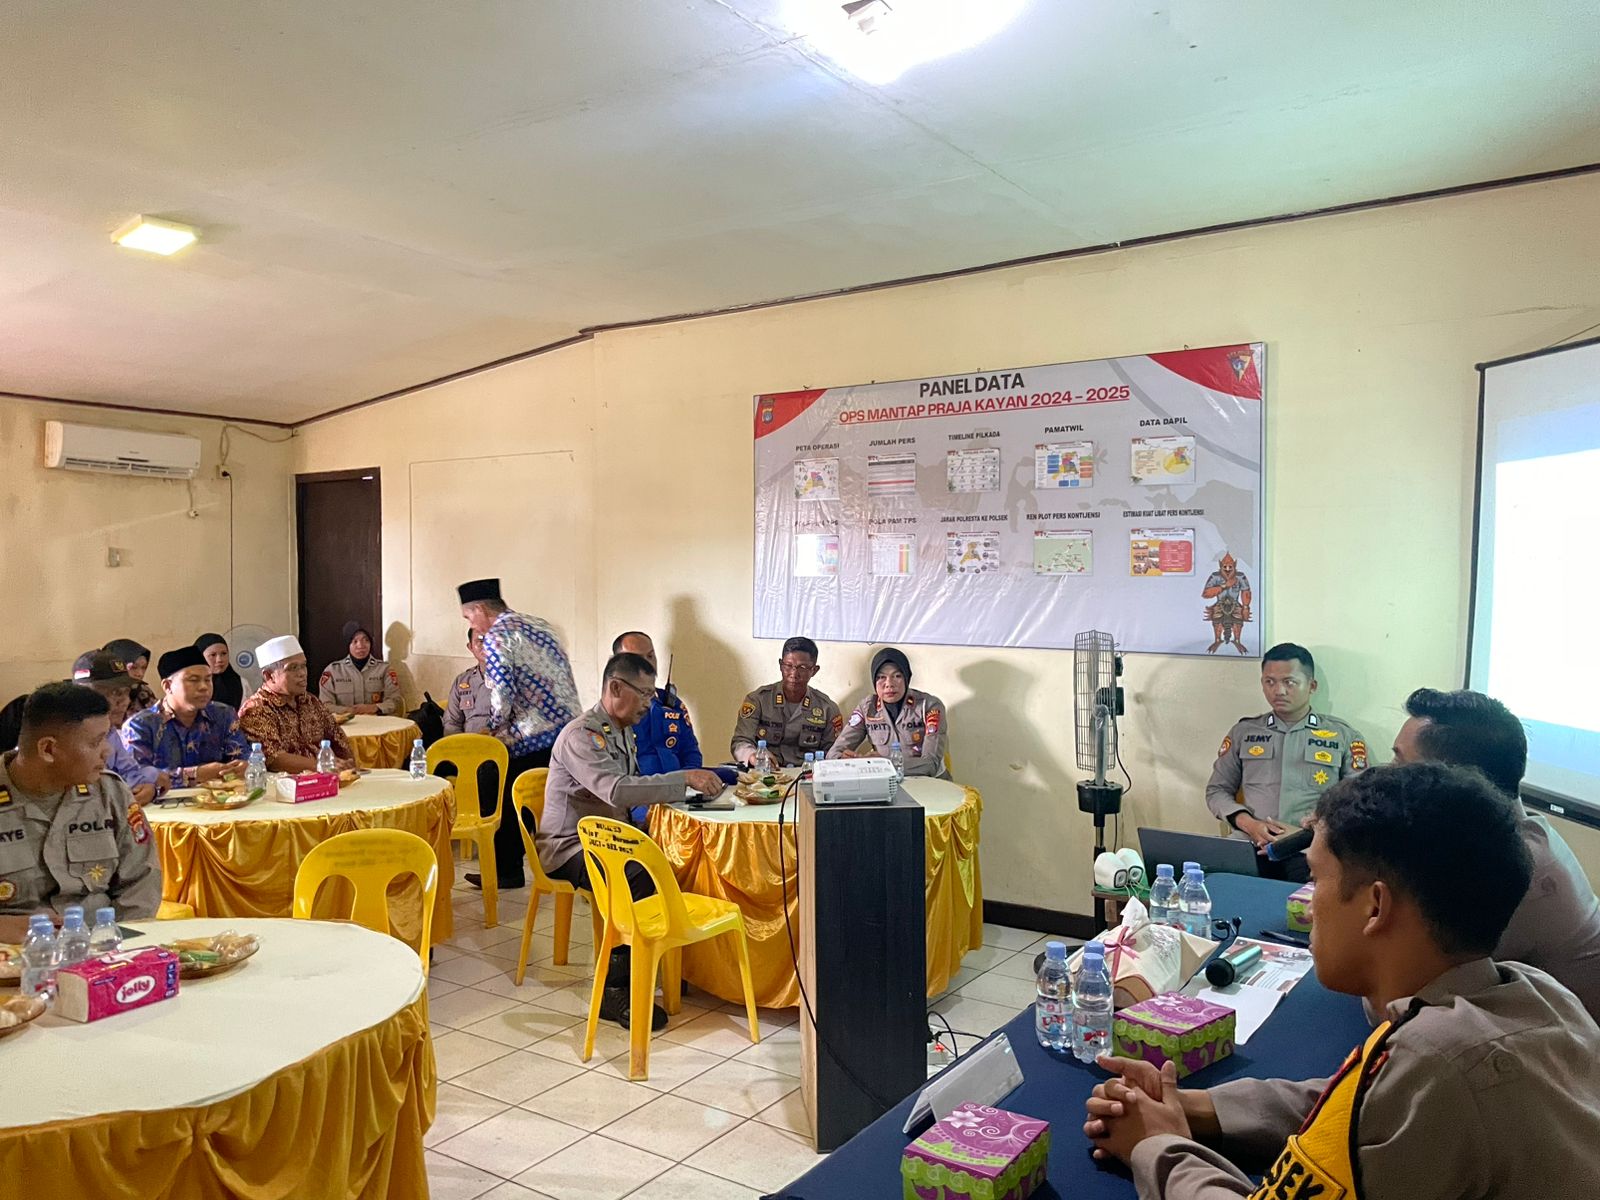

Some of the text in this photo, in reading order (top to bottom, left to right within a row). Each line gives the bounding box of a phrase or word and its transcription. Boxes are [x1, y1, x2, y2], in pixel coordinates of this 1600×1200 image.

[920, 373, 1025, 398] PANEL DATA
[840, 410, 865, 423] OPS
[868, 405, 925, 420] MANTAP
[928, 401, 972, 415] PRAJA
[975, 395, 1028, 411] KAYAN
[1031, 390, 1073, 406] 2024
[1086, 385, 1130, 401] 2025
[1140, 417, 1188, 427] DATA DAPIL
[1044, 425, 1084, 434] PAMATWIL
[948, 431, 1000, 441] TIMELINE PILKADA
[812, 443, 840, 451] OPERASI
[869, 437, 916, 447] JUMLAH PERS
[866, 723, 888, 731] PIPIT
[1244, 735, 1272, 743] JEMY
[1308, 738, 1339, 749] POLRI
[68, 819, 115, 834] POLR
[121, 980, 150, 1001] jolly
